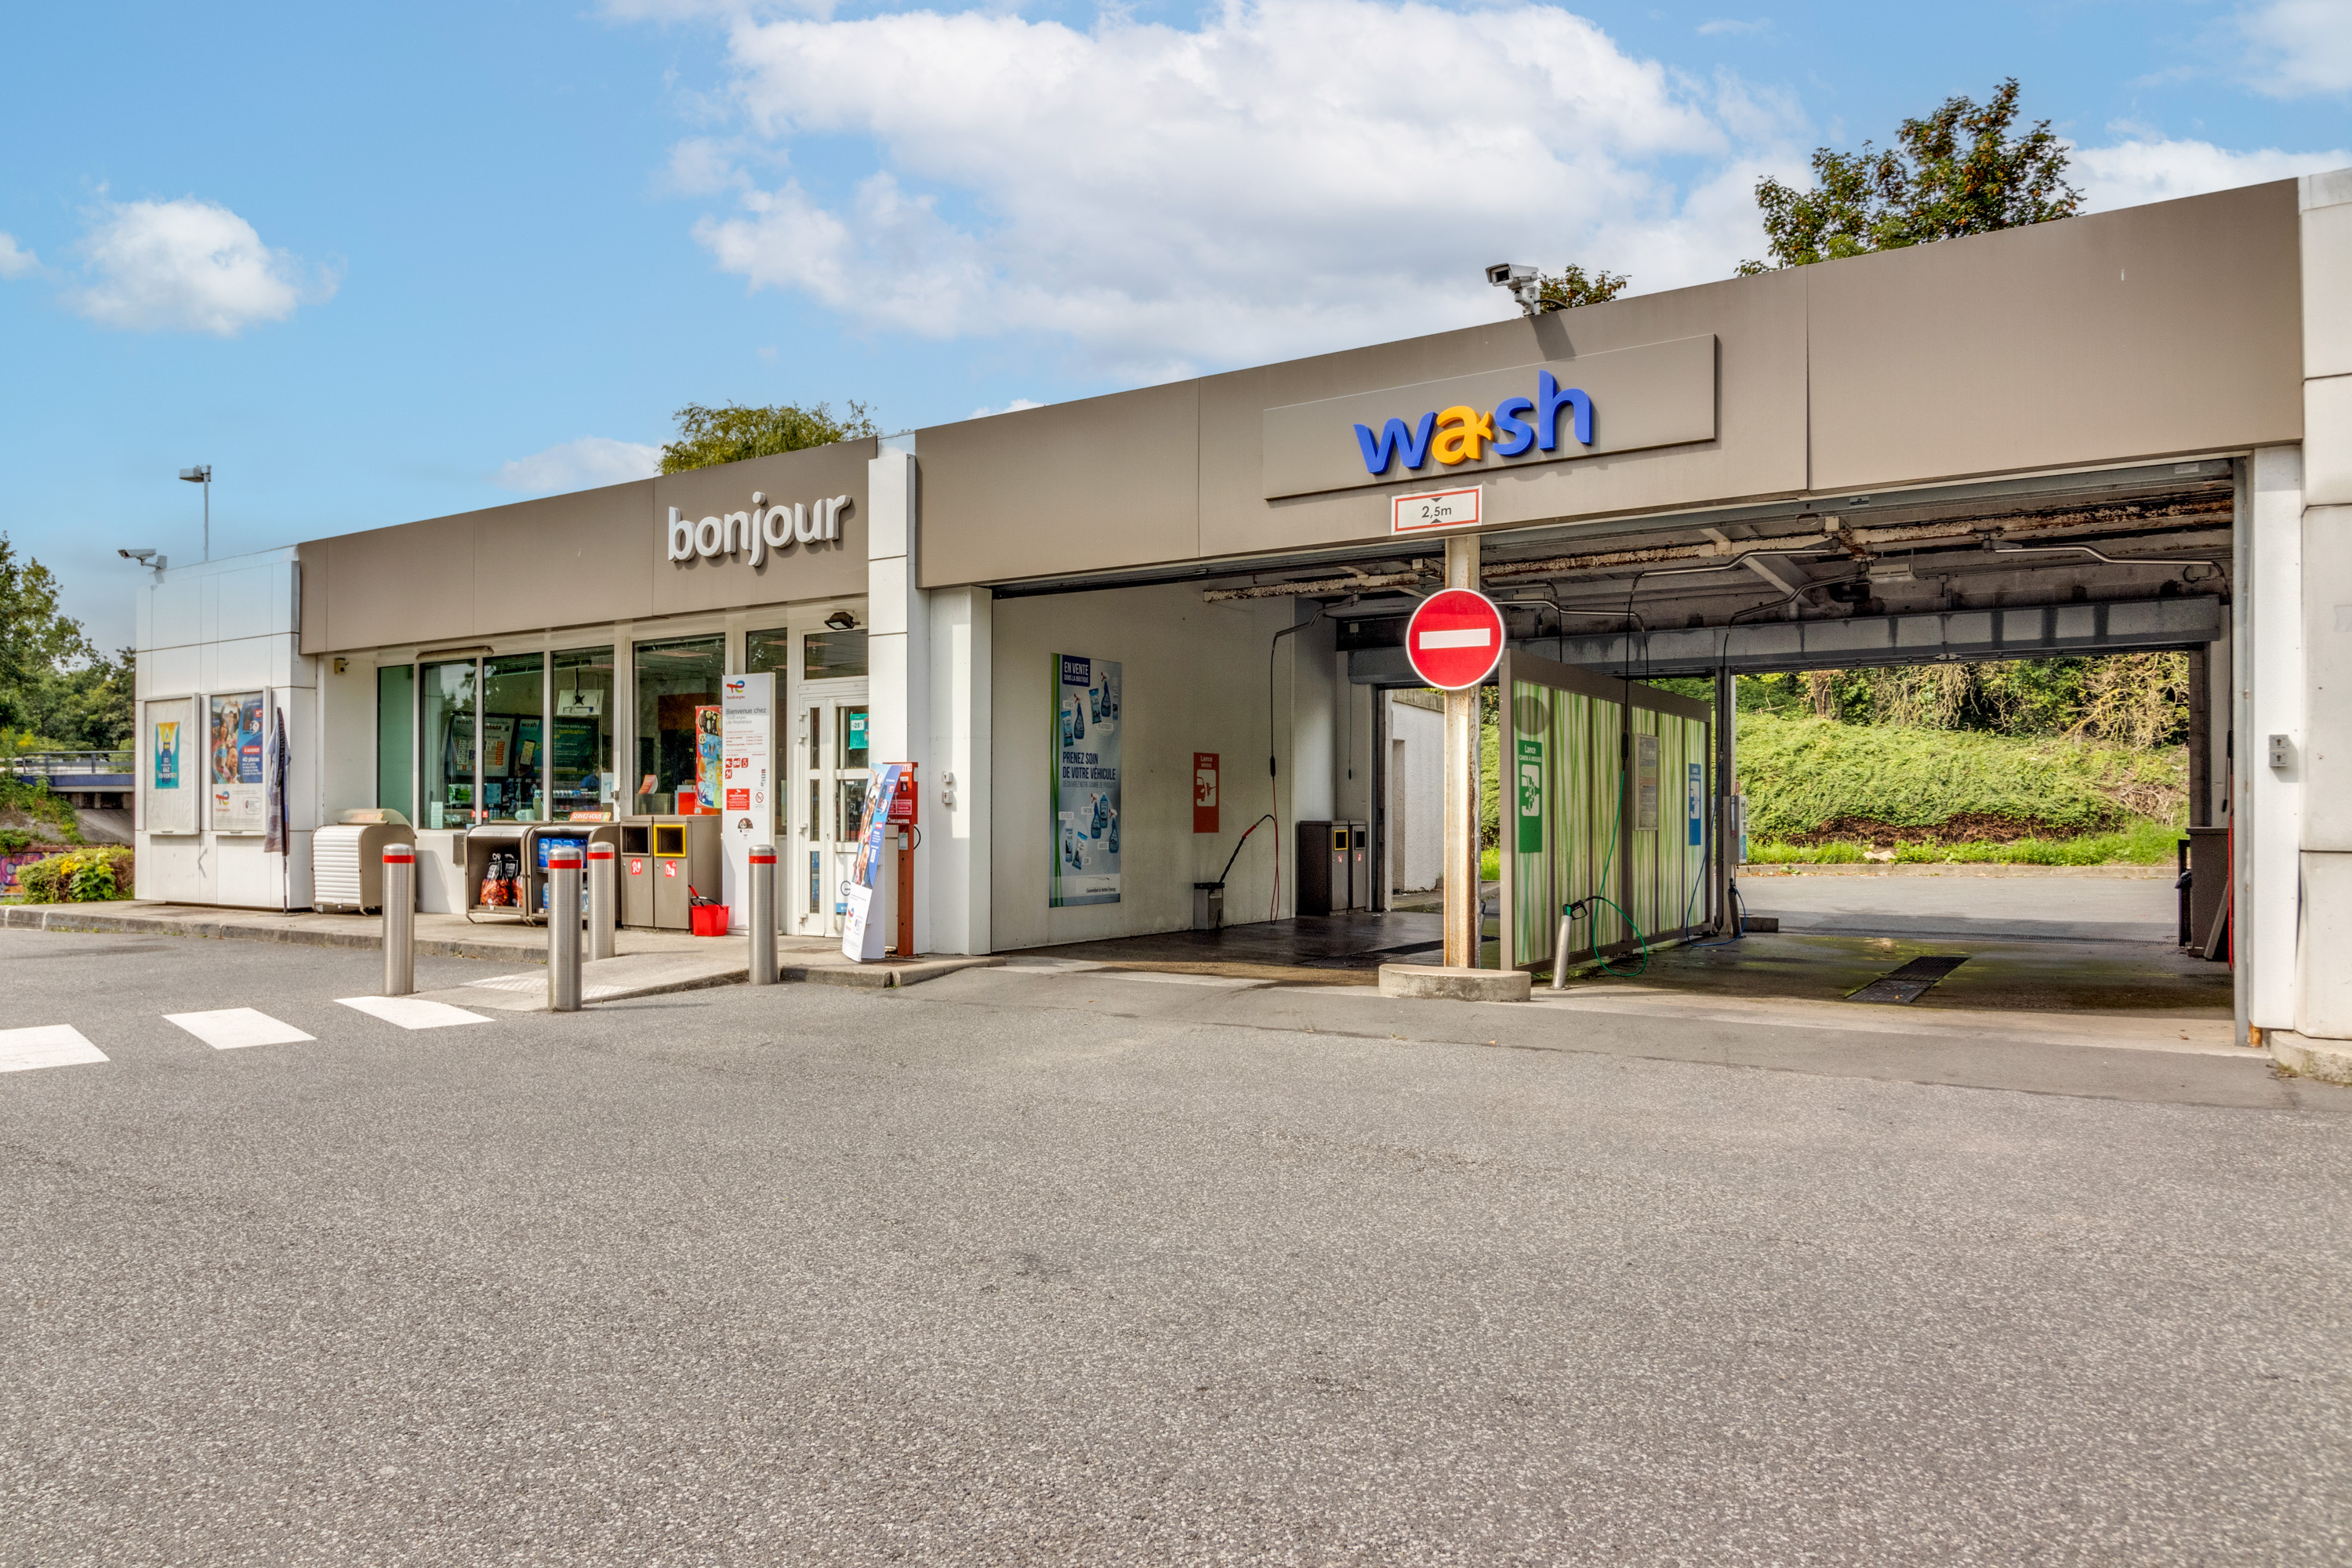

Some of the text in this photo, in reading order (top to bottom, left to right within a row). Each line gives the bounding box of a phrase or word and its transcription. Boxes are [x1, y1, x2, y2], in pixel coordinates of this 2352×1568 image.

[1353, 369, 1592, 475] wash
[1421, 506, 1452, 519] 2,5m
[667, 491, 851, 567] bonjour
[1064, 662, 1089, 675] EN VENTE
[1524, 745, 1537, 754] Lance
[1062, 751, 1098, 764] PRENEZ SOIN
[1062, 766, 1116, 779] DE VOTRE VÉHICULE
